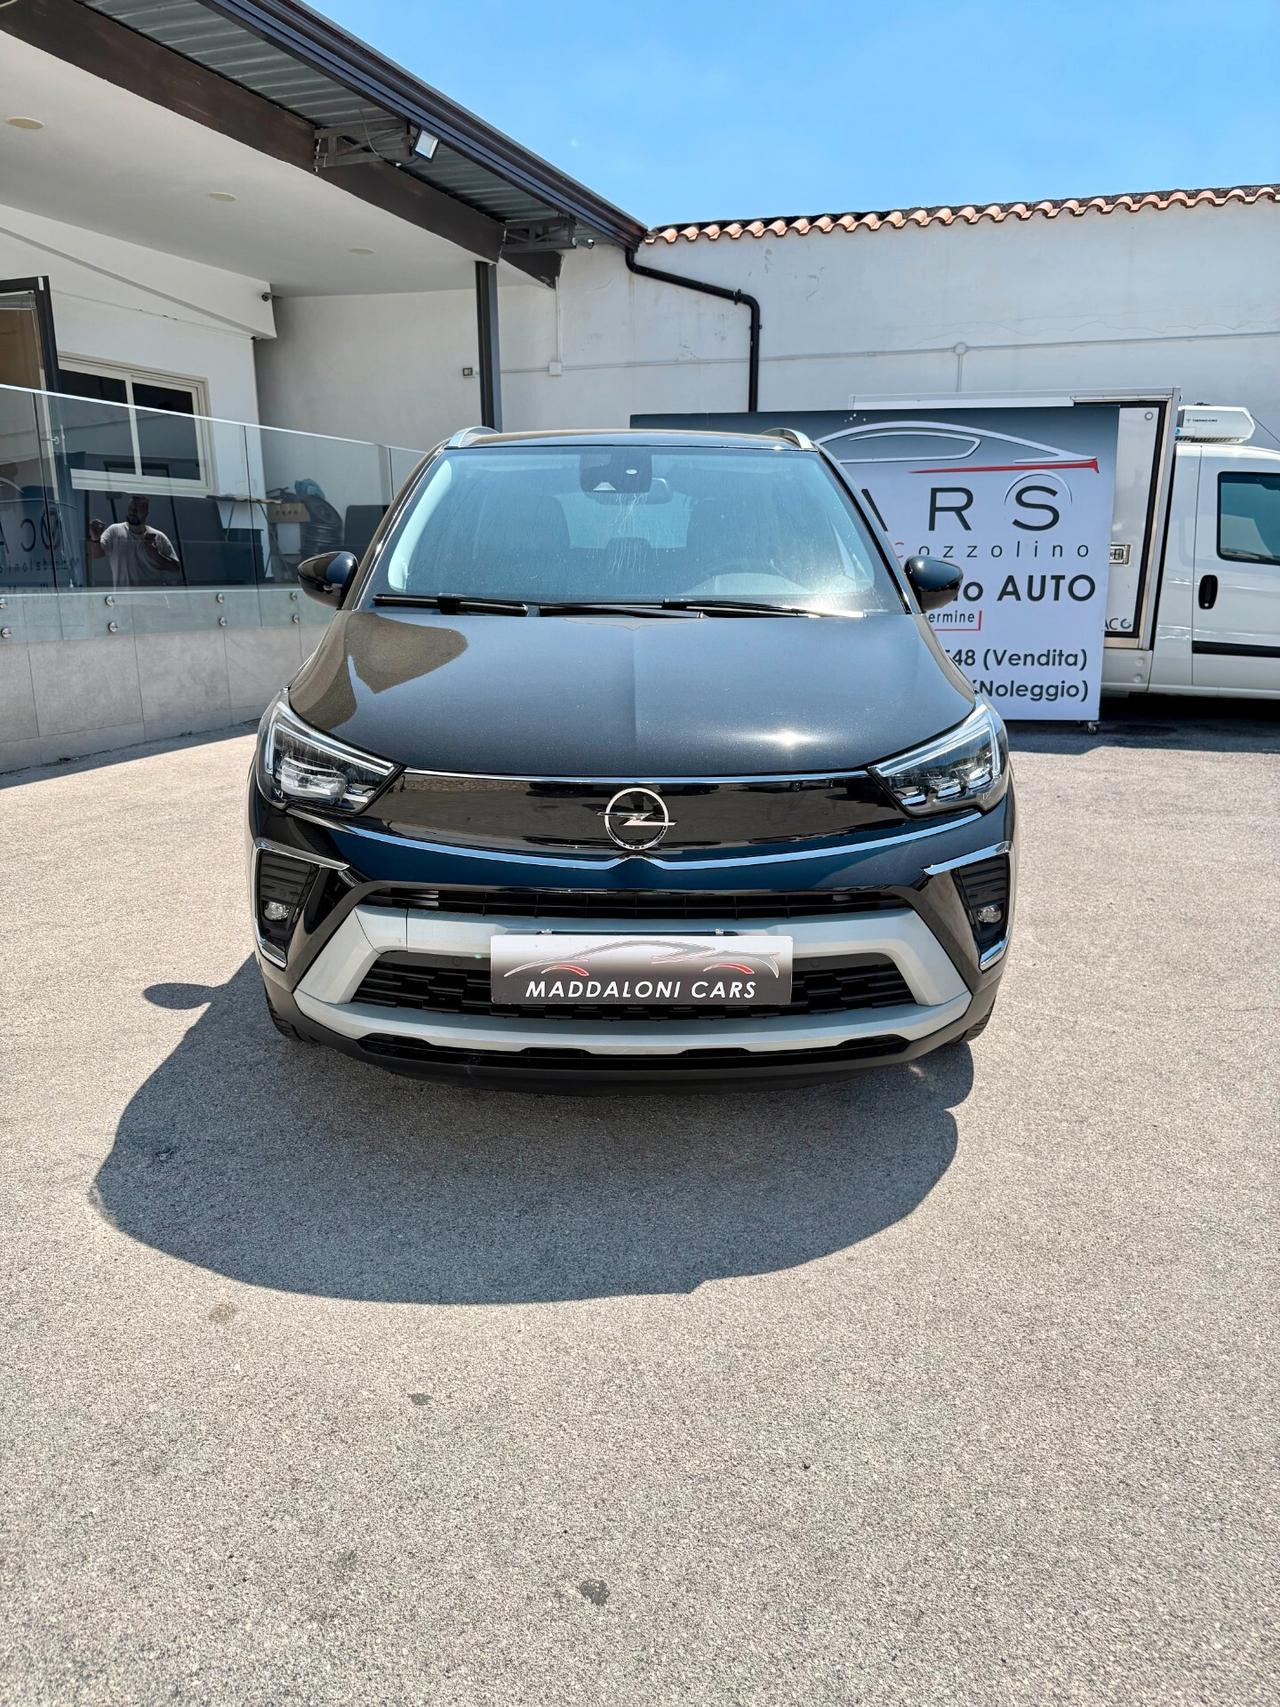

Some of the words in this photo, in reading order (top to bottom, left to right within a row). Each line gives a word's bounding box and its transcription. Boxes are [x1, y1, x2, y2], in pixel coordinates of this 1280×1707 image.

[997, 574, 1096, 602] AUTO
[928, 609, 975, 623] ermine
[945, 649, 976, 666] 48
[983, 648, 1088, 671] (Vendita)
[525, 980, 682, 999] MADDALONI
[690, 980, 757, 999] CARS
